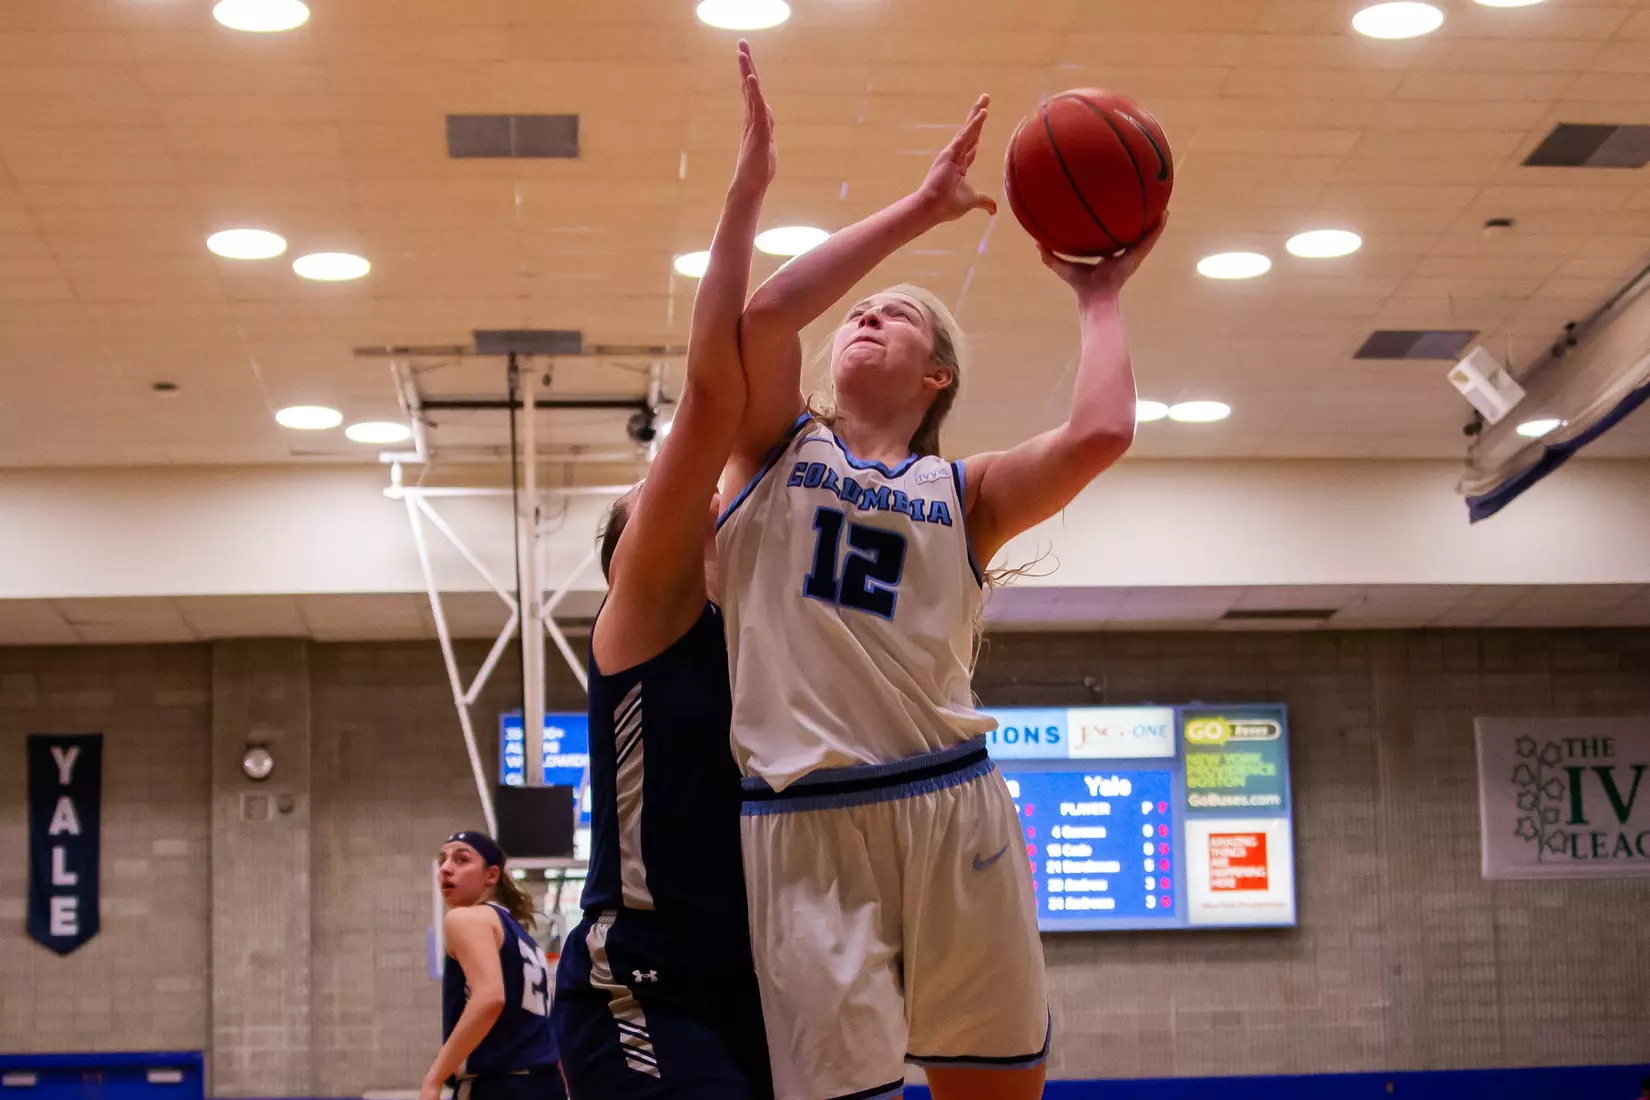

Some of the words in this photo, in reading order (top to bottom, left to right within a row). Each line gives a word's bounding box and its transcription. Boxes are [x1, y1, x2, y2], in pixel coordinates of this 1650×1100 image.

[787, 462, 952, 527] COLUMBIA
[802, 505, 908, 621] 12
[991, 725, 1061, 745] IONS
[1187, 722, 1223, 740] GO
[1562, 737, 1615, 758] THE
[1084, 775, 1132, 797] Yale
[1562, 764, 1649, 825] IV
[48, 746, 81, 937] YALE
[1570, 830, 1650, 860] LEAG
